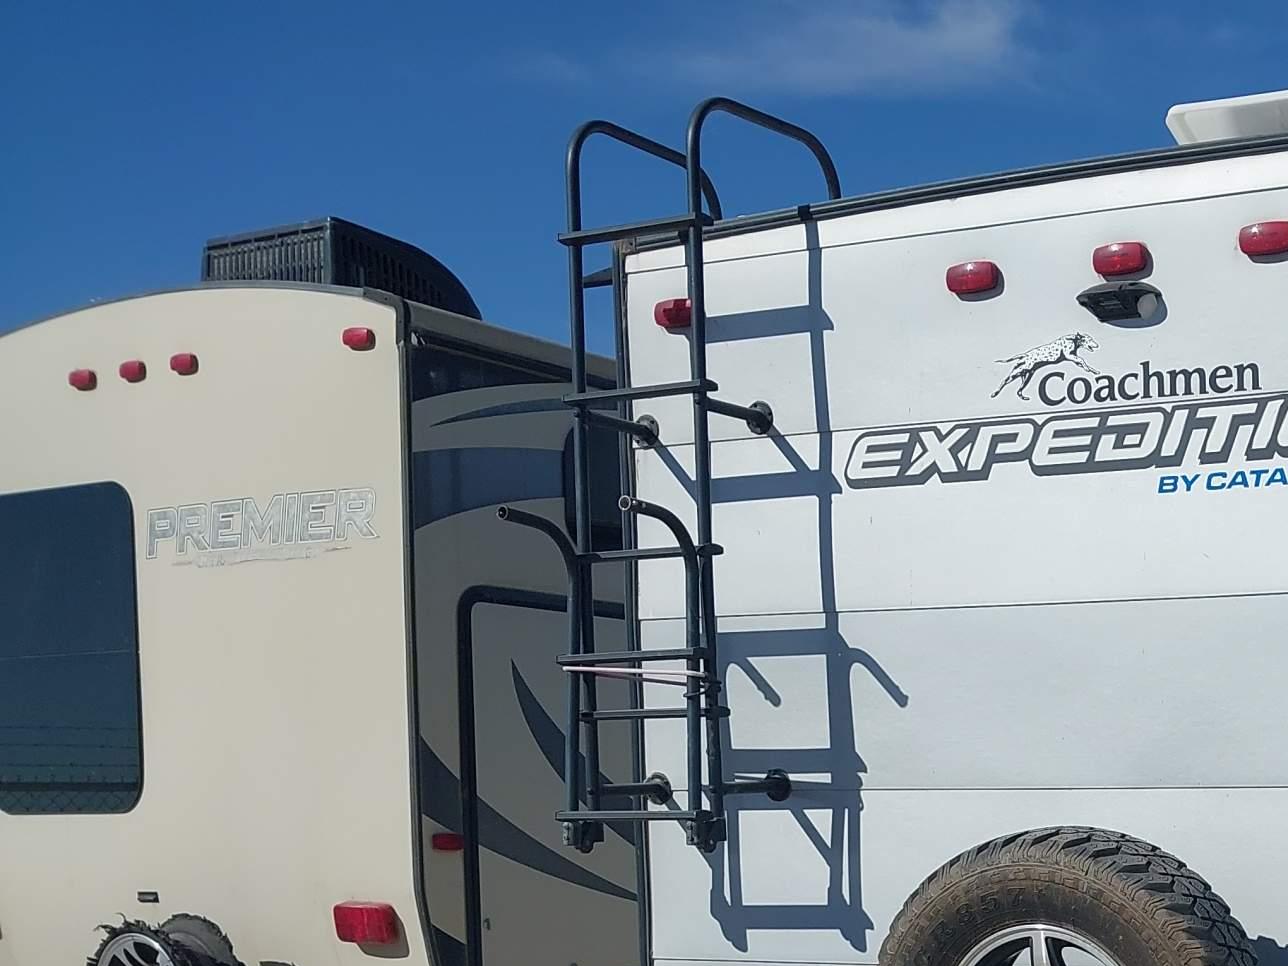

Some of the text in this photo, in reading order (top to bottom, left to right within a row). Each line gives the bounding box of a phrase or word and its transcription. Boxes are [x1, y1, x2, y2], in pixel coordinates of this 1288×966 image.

[1039, 360, 1262, 407] Coachmen
[1157, 471, 1196, 495] BY
[145, 487, 380, 559] PREMIER
